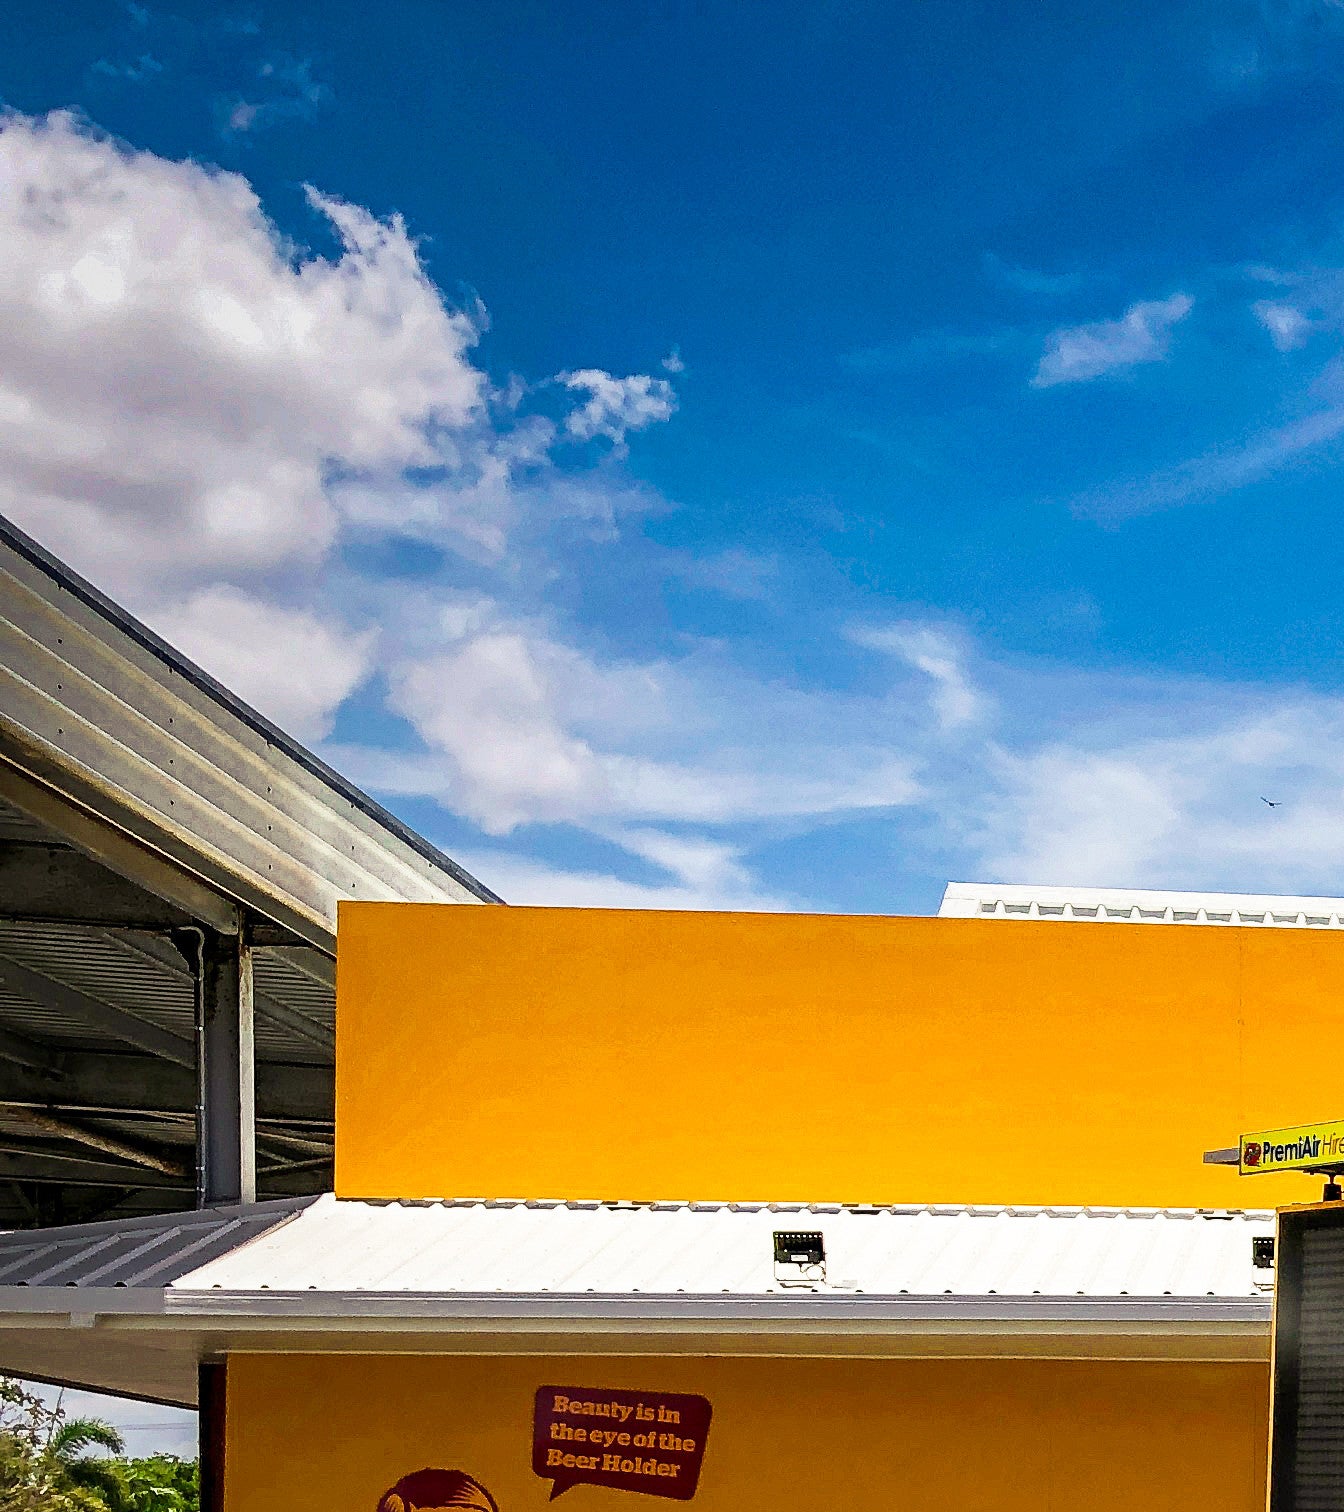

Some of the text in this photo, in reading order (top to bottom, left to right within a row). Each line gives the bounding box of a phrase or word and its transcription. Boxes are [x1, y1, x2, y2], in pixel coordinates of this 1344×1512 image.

[1262, 1134, 1321, 1164] PremiAir
[552, 1395, 681, 1424] Beauty is in
[550, 1422, 696, 1452] the eye of the
[547, 1448, 681, 1478] Beer Holder
